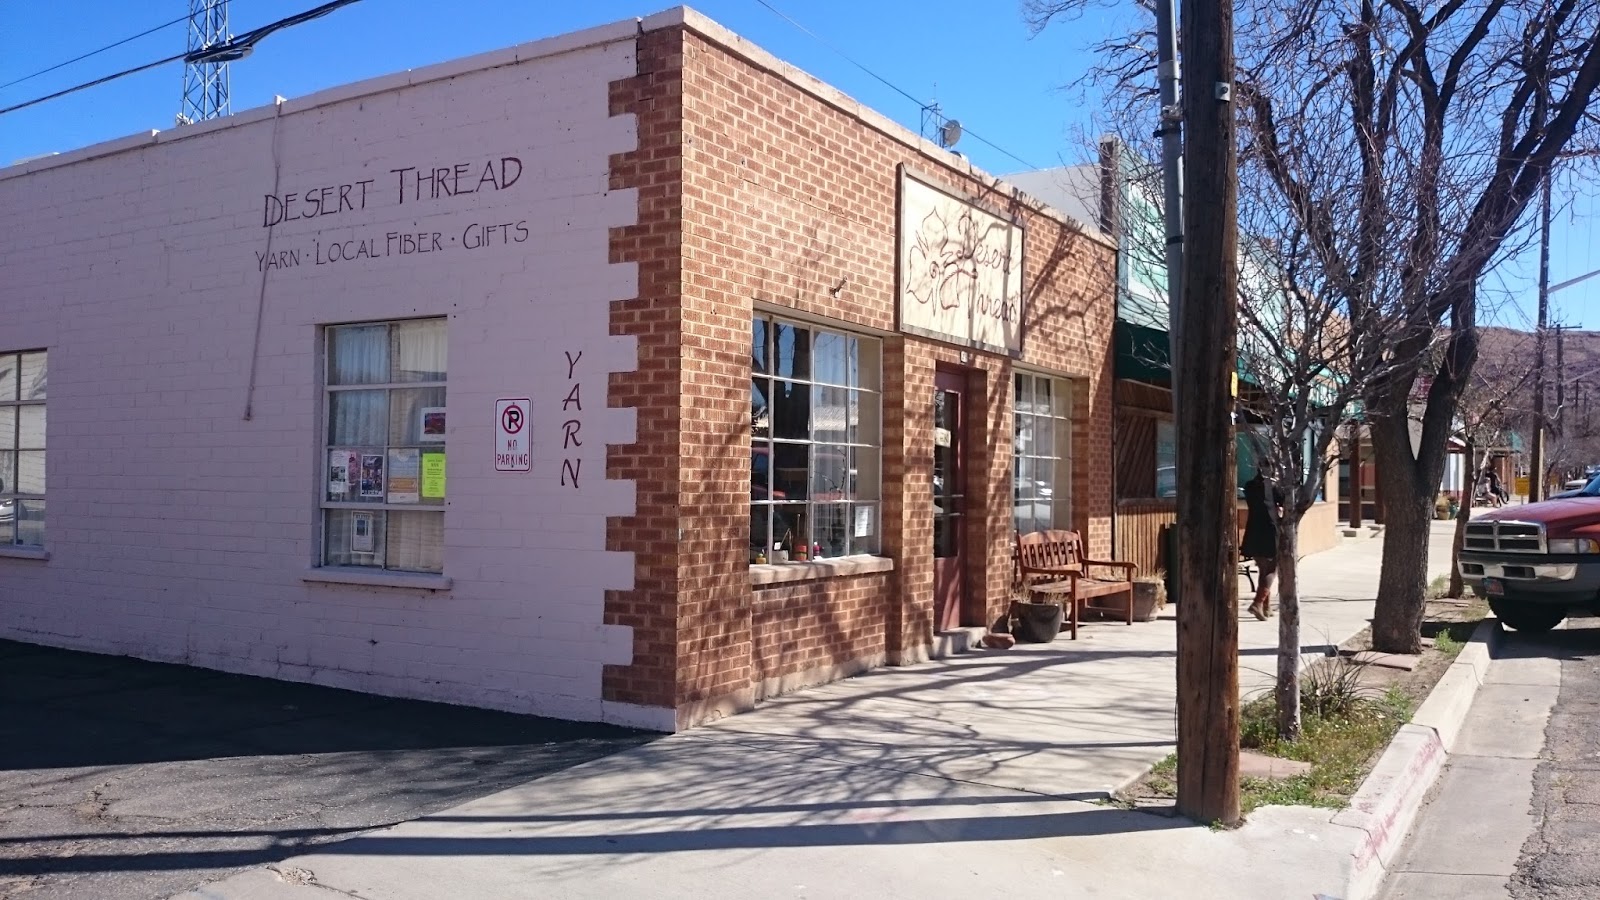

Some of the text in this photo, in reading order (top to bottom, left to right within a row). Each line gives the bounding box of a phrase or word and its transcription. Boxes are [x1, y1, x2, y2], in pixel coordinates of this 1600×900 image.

[263, 156, 523, 228] DESERT THREAD
[255, 220, 530, 272] YARN LOCAL FIBER GIFTS
[957, 212, 1012, 275] Desert
[507, 439, 518, 451] NO
[561, 350, 583, 489] YARN
[497, 453, 528, 466] PARKING
